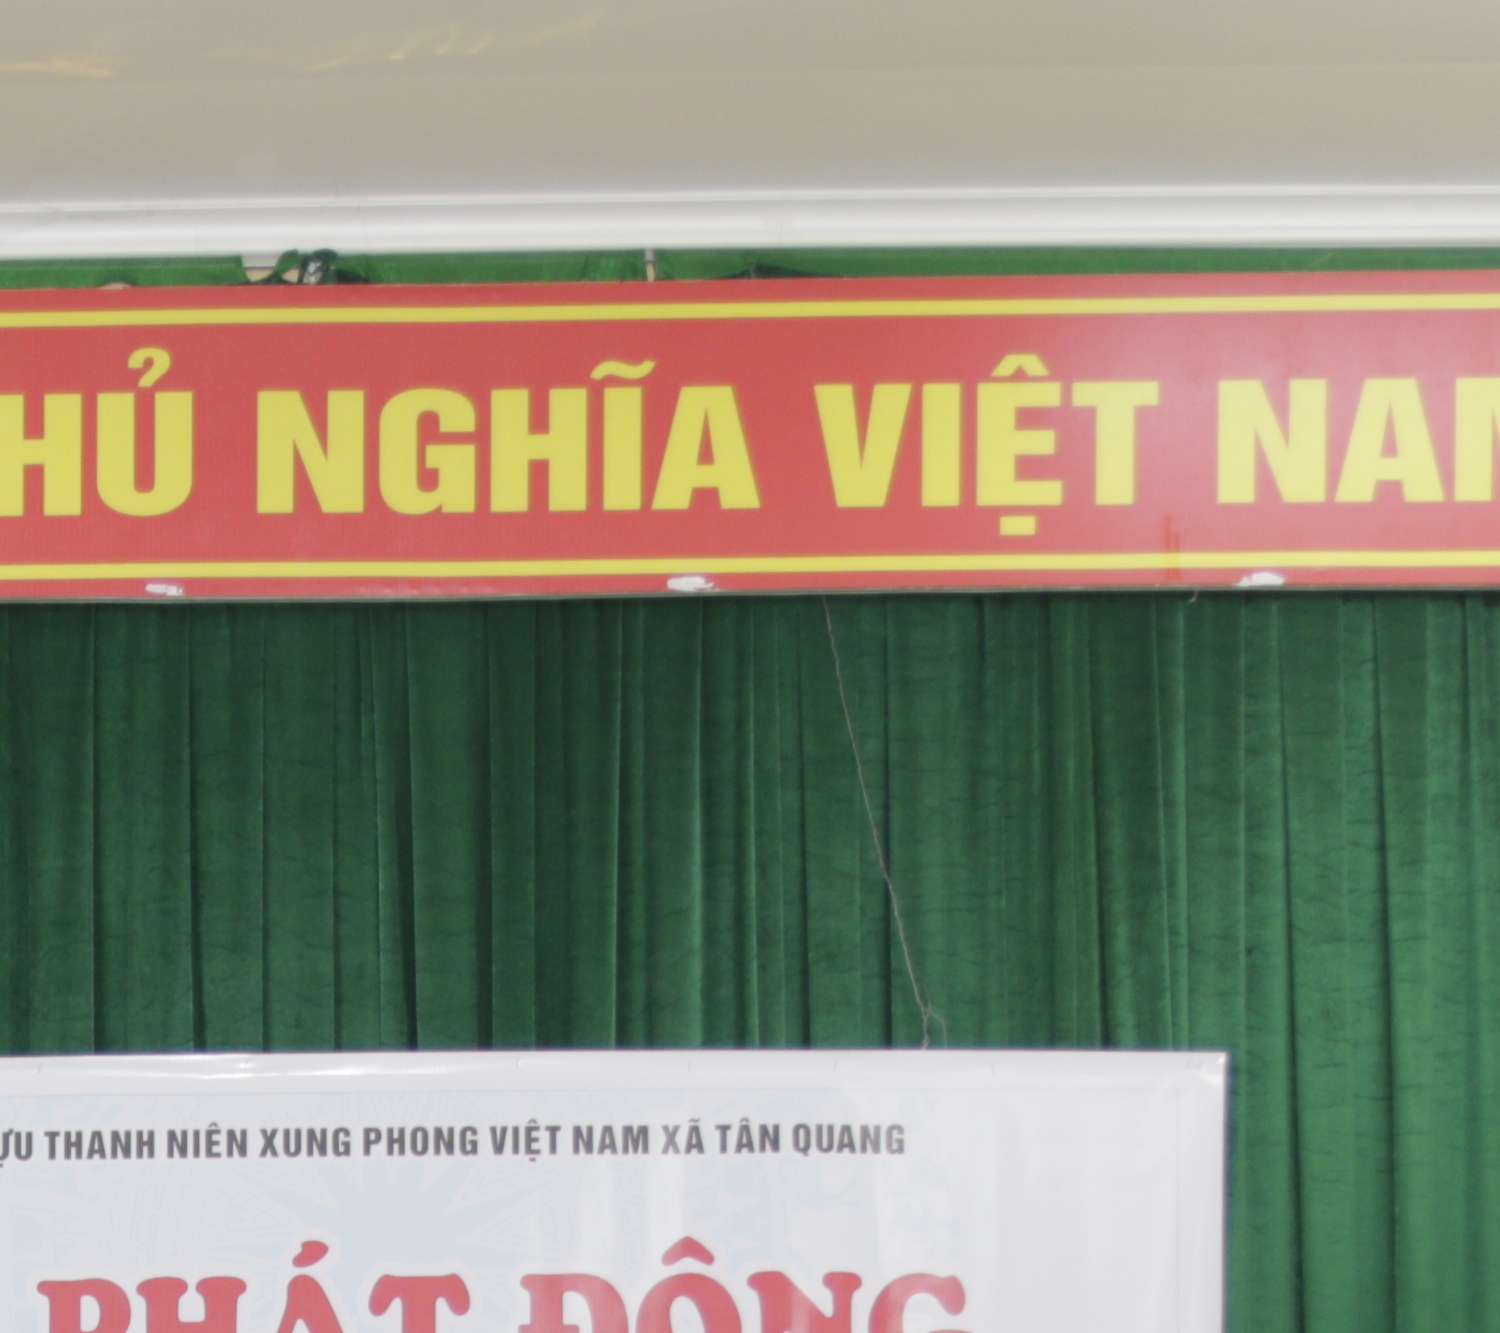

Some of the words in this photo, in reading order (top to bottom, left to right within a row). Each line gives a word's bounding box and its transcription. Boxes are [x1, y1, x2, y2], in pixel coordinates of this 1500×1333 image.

[256, 358, 761, 515] NGHĨA
[815, 354, 1160, 536] VIỆT
[45, 1130, 155, 1160] THANH
[167, 1122, 248, 1158] NIÊN
[260, 1127, 351, 1157] XUNG
[363, 1126, 478, 1156] PHONG
[490, 1119, 561, 1162] VIỆT
[573, 1125, 649, 1154] NAM
[661, 1118, 705, 1154] XÃ
[715, 1118, 780, 1153] TÂN
[792, 1123, 905, 1155] QUANG
